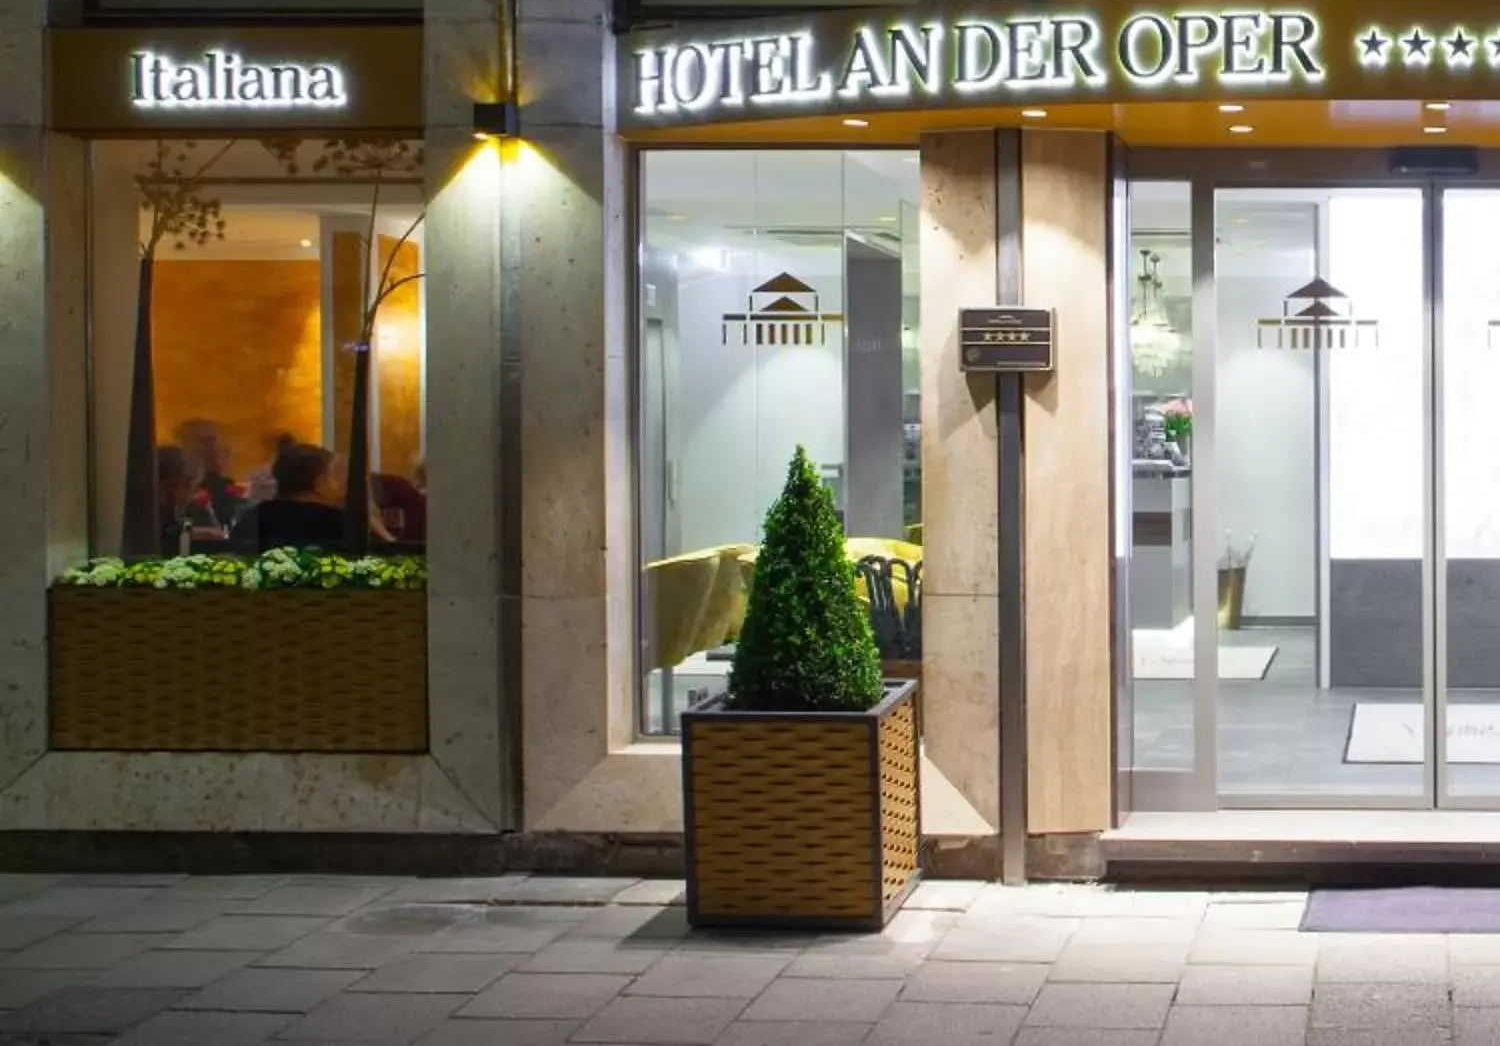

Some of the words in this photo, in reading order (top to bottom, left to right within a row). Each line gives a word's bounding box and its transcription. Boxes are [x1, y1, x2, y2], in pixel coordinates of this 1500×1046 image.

[129, 49, 348, 108] Italiana
[632, 34, 822, 114] HOTEL
[838, 26, 937, 96] AN
[952, 18, 1102, 88] DER
[1117, 12, 1323, 82] OPER
